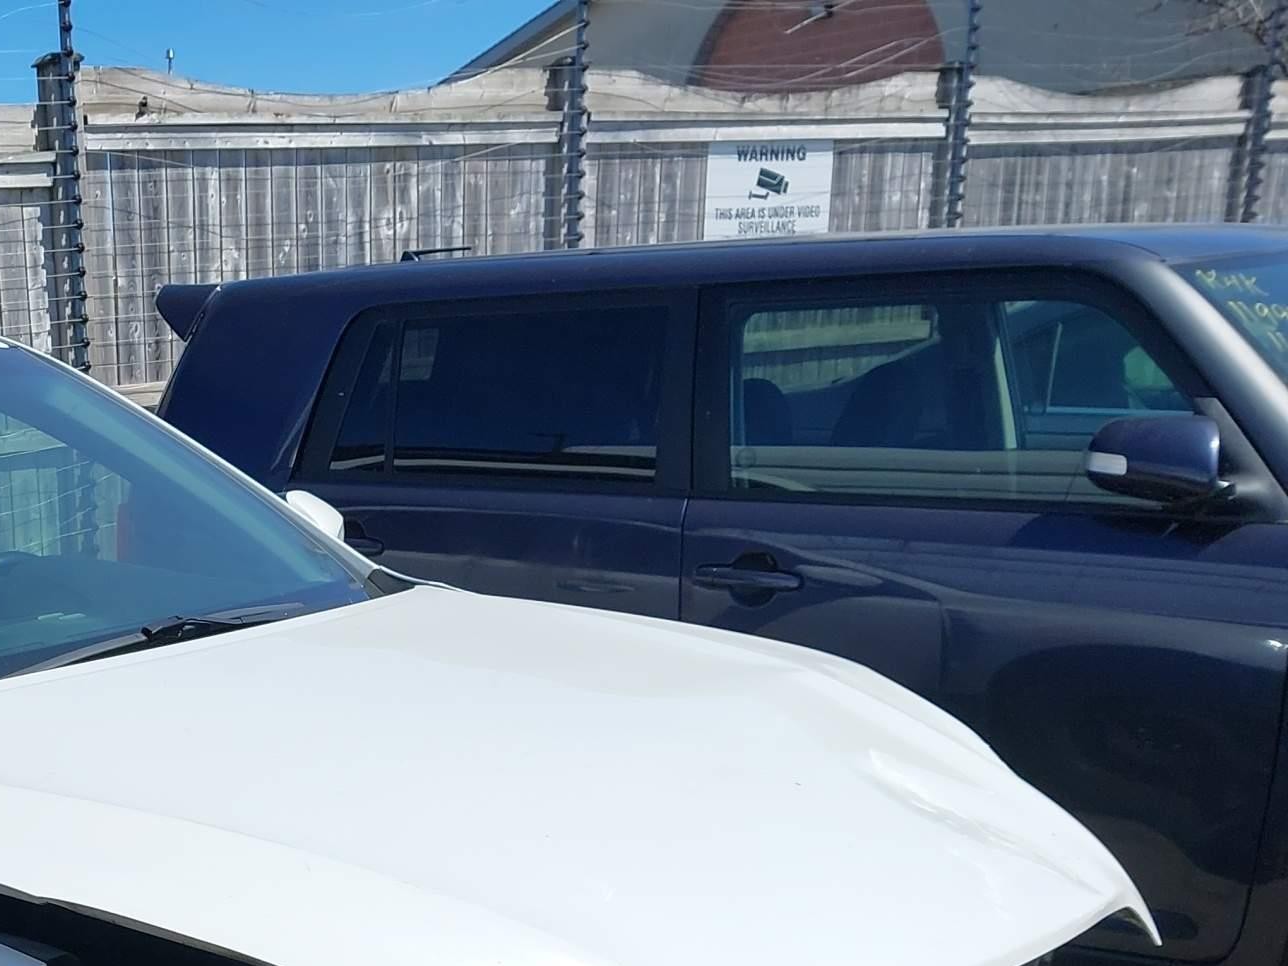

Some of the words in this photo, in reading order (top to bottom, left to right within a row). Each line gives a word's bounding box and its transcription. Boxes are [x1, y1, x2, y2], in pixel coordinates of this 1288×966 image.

[736, 144, 808, 163] WARNING
[715, 207, 733, 220] THIS
[734, 207, 755, 219] AREA
[757, 207, 766, 219] IS
[768, 206, 795, 219] UNDER
[796, 205, 821, 218] VIDEO
[738, 219, 797, 235] SURVEILLANCE
